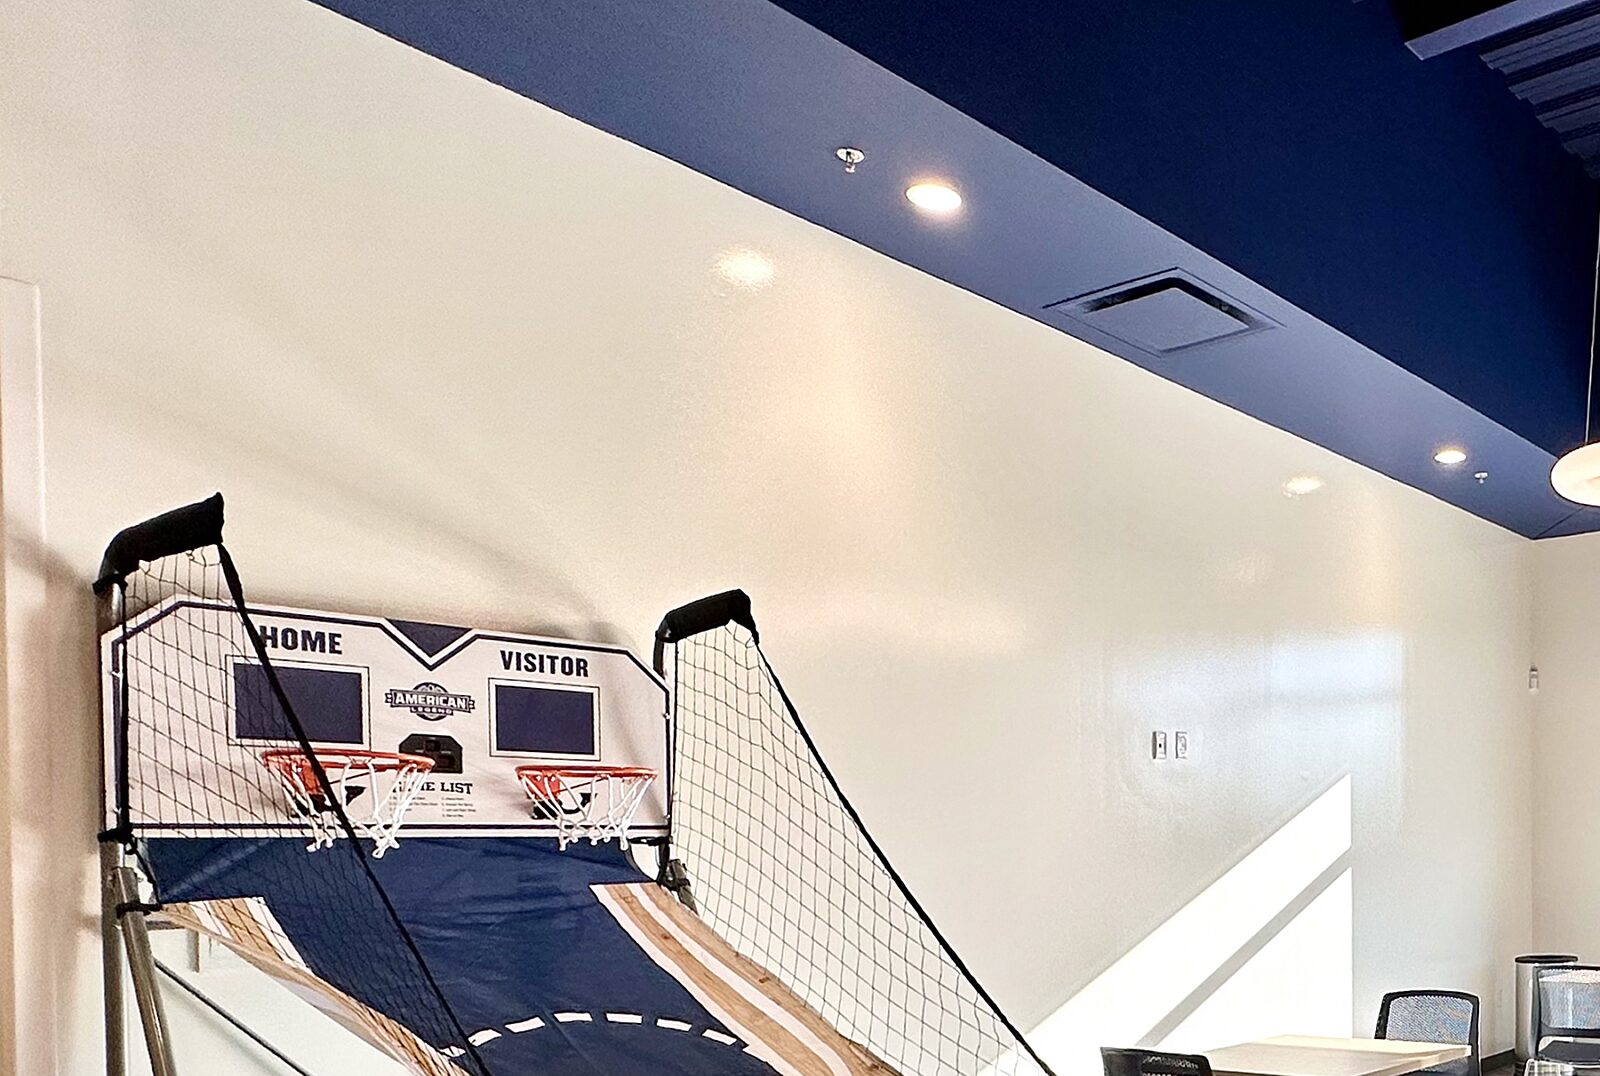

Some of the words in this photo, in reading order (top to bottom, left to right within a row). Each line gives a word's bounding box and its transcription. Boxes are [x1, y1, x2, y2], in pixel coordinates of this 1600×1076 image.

[259, 625, 342, 655] HOME
[500, 649, 589, 677] VISITOR
[395, 693, 466, 709] AMERICAN
[440, 782, 473, 794] LIST
